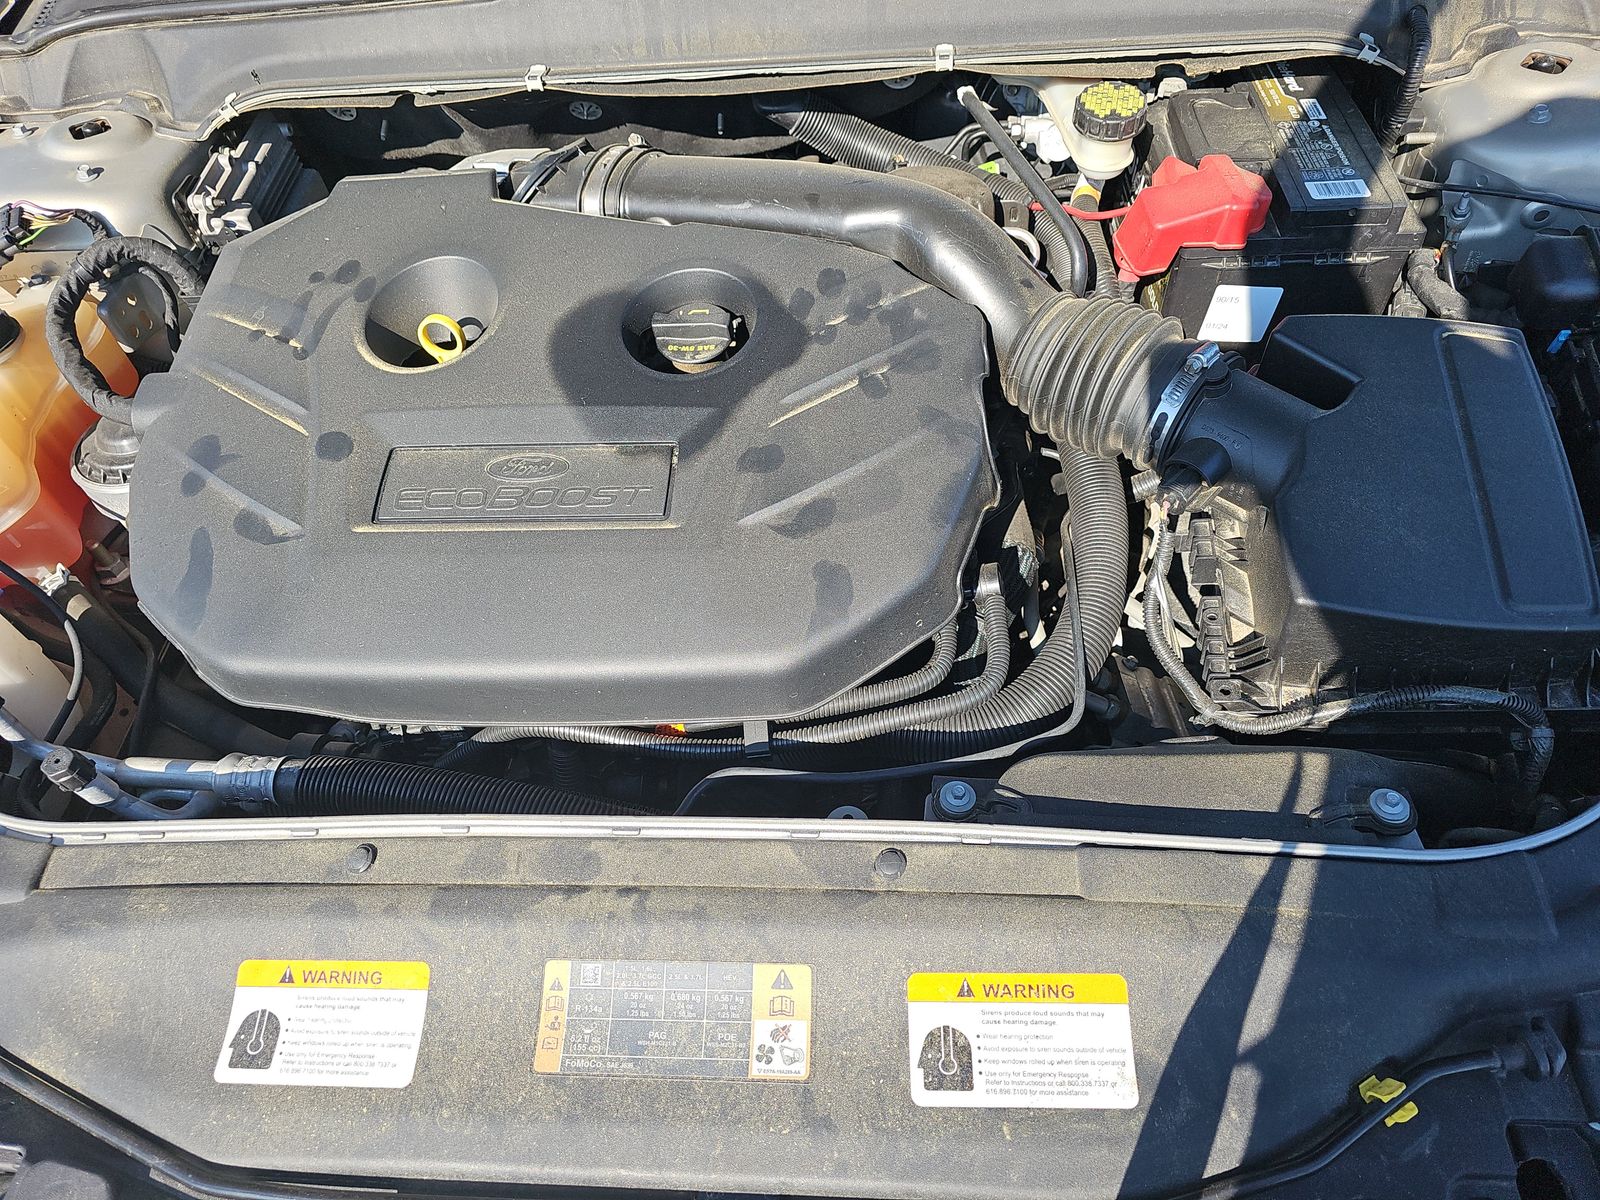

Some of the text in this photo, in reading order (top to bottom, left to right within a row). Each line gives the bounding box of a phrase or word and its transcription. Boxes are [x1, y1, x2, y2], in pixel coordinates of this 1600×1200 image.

[502, 457, 555, 475] Ford
[393, 484, 653, 512] ECOBOOST
[302, 970, 383, 985] WARNING
[982, 983, 1075, 999] WARNING
[644, 992, 654, 1002] kg
[692, 993, 701, 1003] kg
[735, 995, 744, 1004] kg
[575, 1004, 602, 1013] R-134a
[1003, 1018, 1028, 1026] hearing
[565, 1059, 602, 1068] FoMoCo
